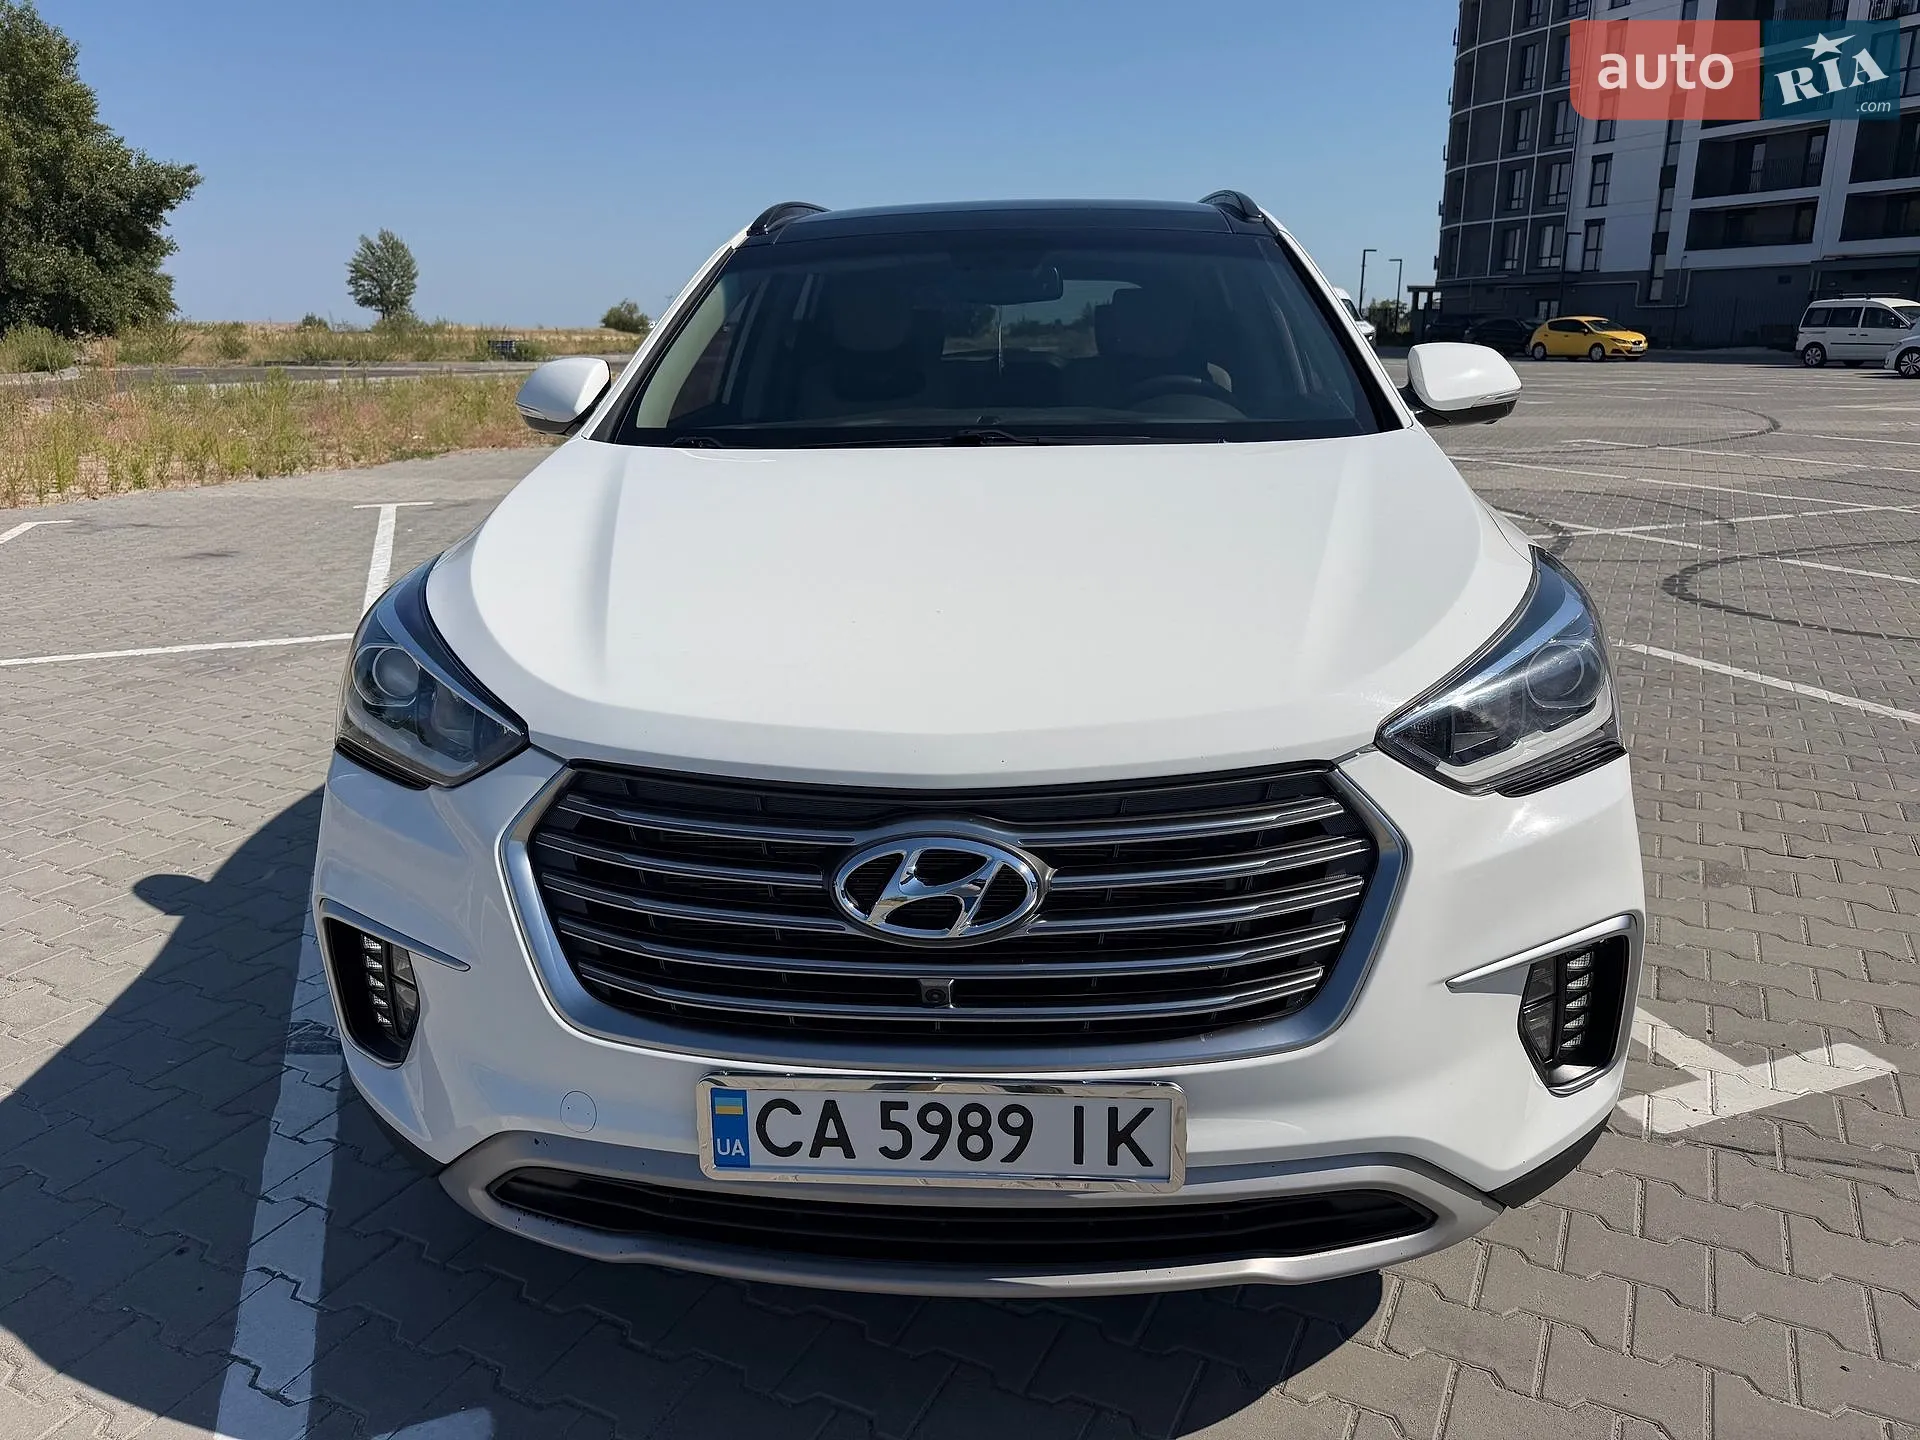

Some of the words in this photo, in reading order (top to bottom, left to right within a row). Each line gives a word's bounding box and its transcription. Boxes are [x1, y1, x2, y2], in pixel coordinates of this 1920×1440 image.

[716, 1139, 746, 1157] UA
[755, 1098, 856, 1160] CA
[879, 1101, 1034, 1163] 5989
[1073, 1105, 1155, 1168] IK
